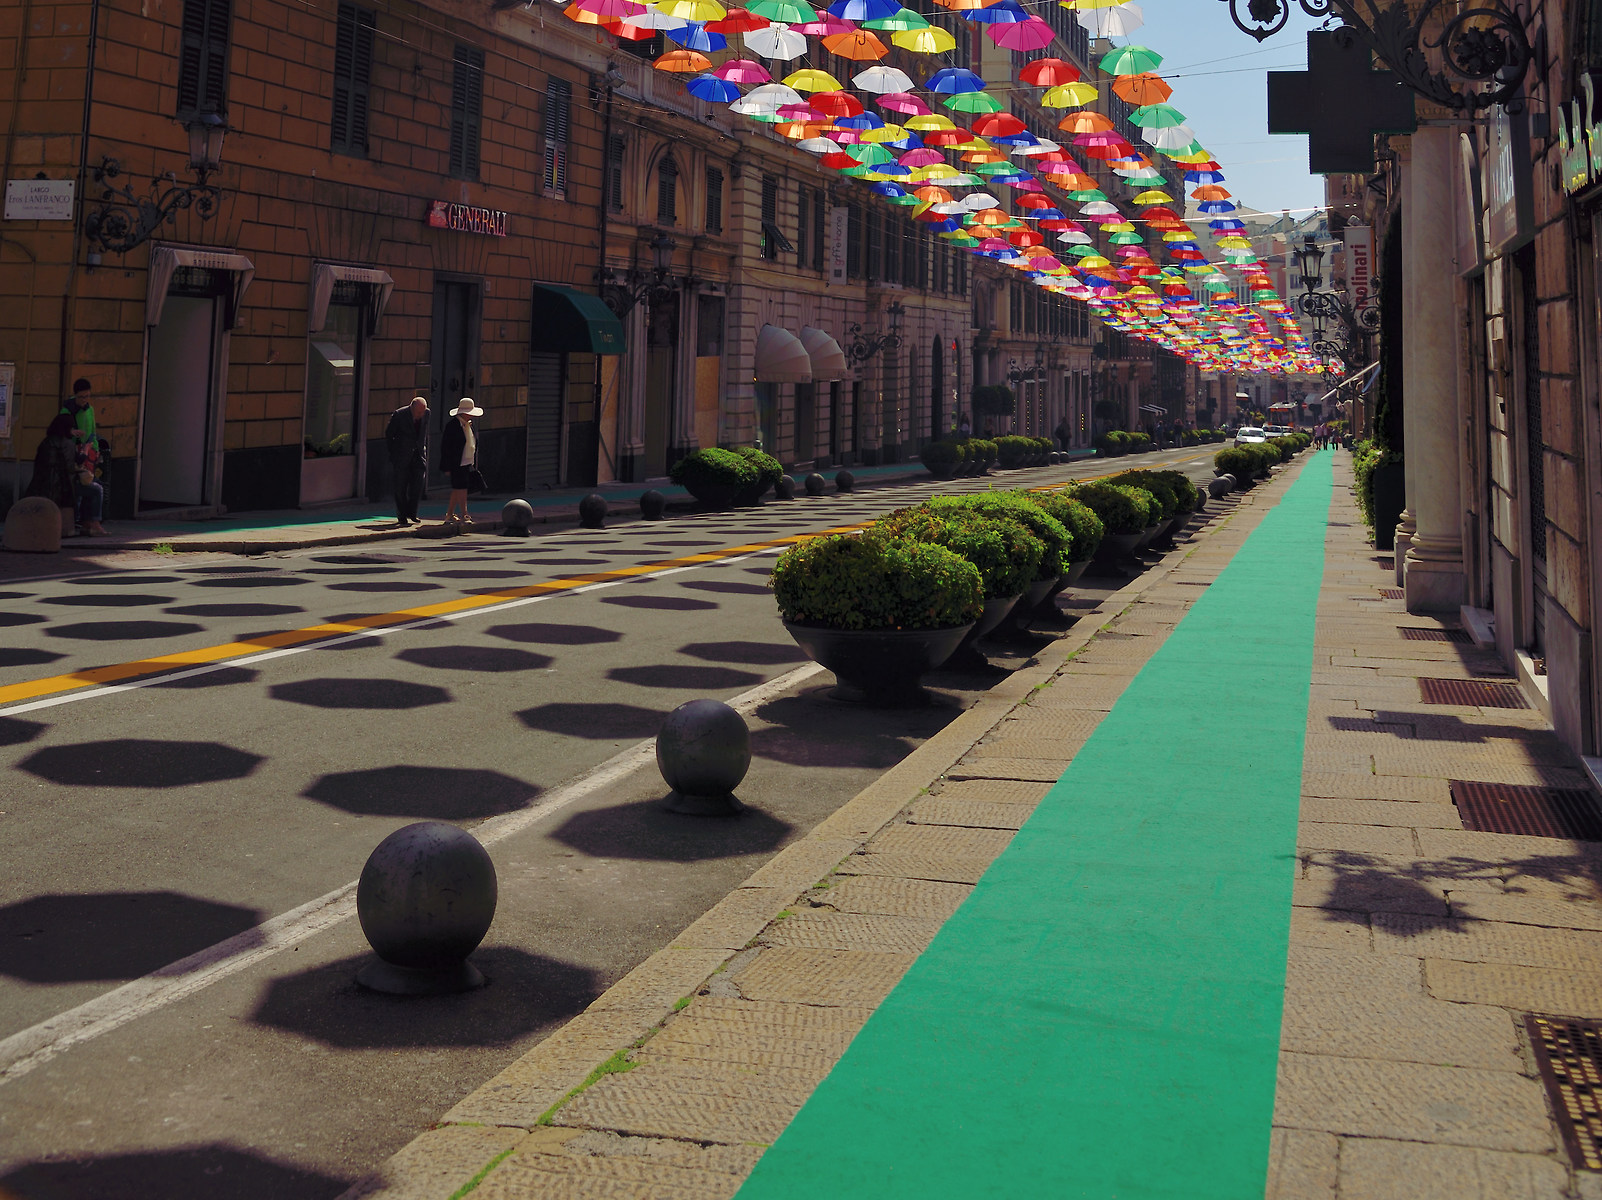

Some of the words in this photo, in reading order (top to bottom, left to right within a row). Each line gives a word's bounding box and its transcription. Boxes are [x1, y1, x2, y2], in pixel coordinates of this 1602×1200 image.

[25, 194, 71, 204] LANFRANCO
[448, 203, 507, 237] GENERALI
[1349, 244, 1368, 310] molinari
